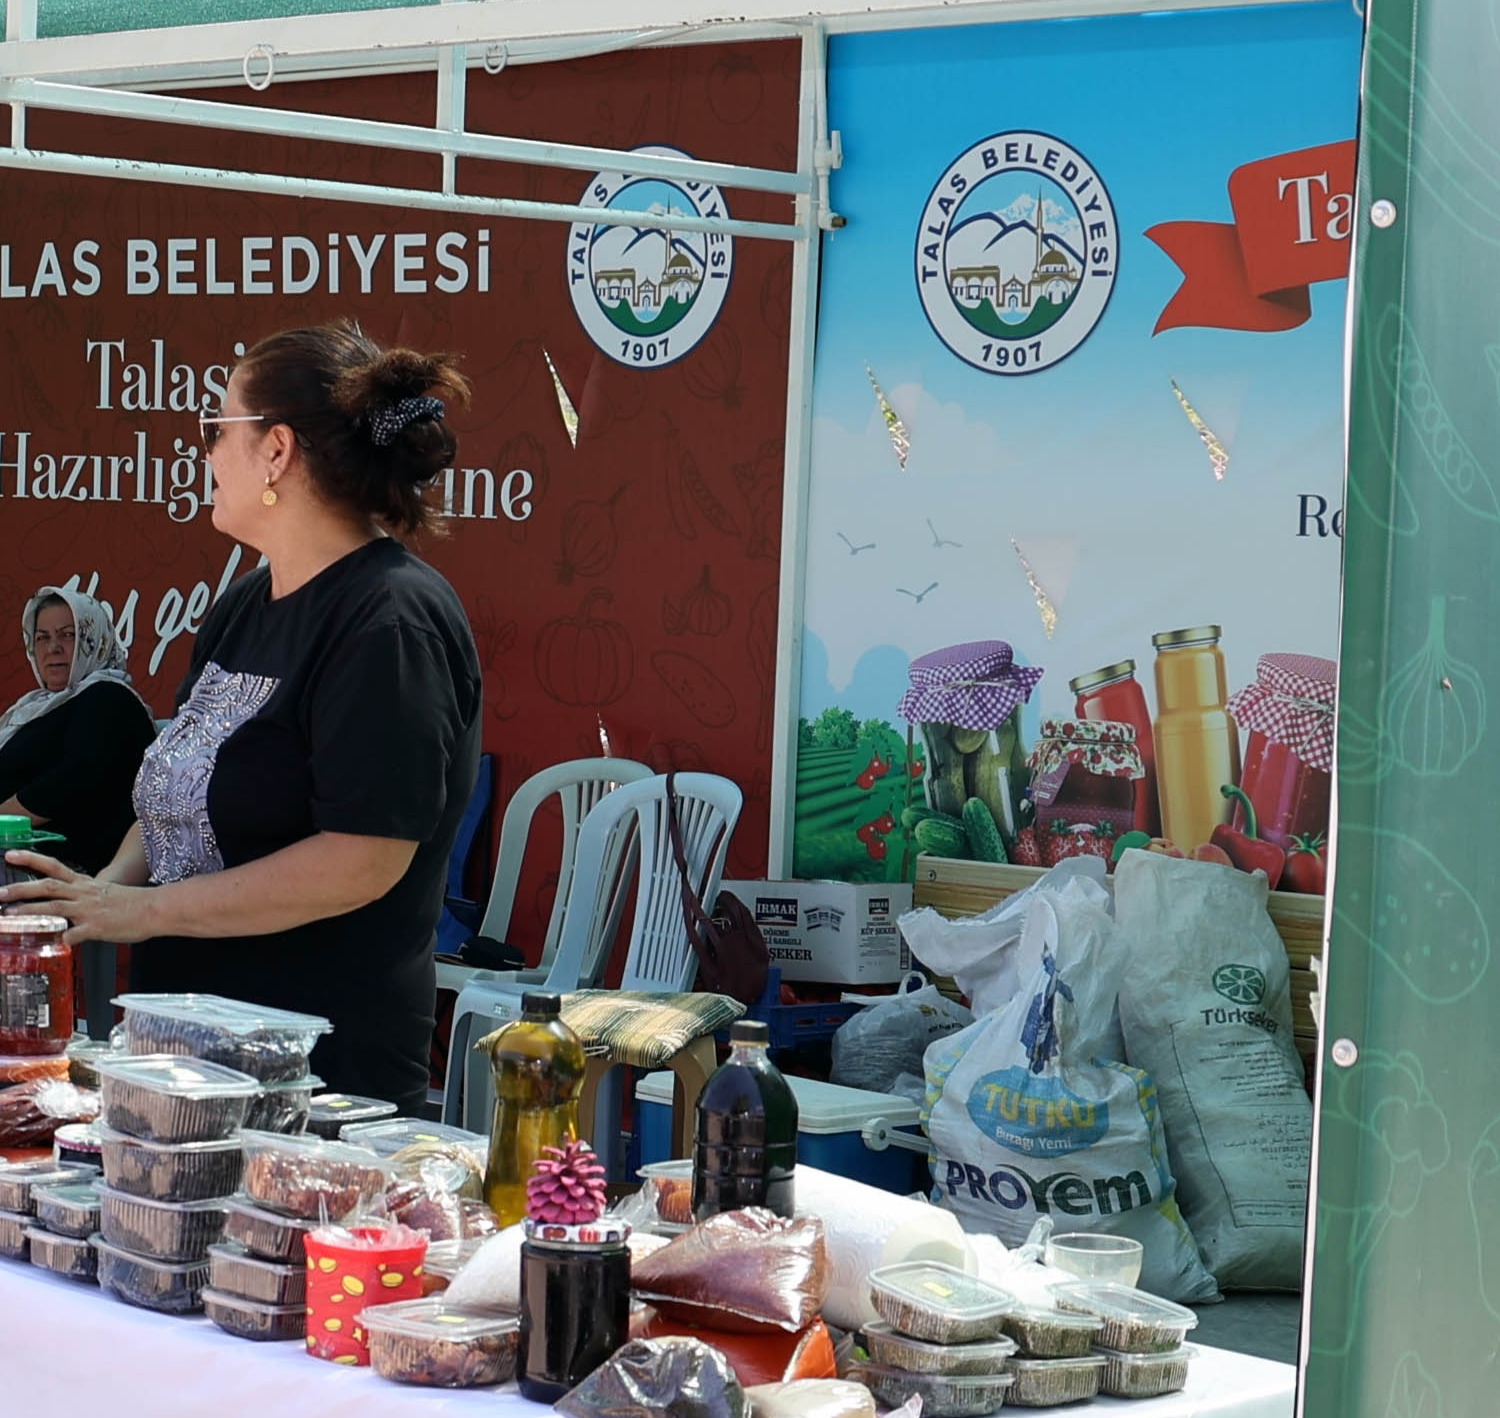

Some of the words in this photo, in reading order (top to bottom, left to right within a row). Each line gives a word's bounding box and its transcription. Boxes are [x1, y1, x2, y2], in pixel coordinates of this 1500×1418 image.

[921, 170, 968, 283] TALAS
[980, 142, 1114, 280] BELEDİYESİ
[571, 183, 608, 286] TALS
[125, 228, 491, 295] BELEDİYESİ
[620, 337, 670, 361] 1907
[981, 340, 1044, 367] 1907
[756, 902, 798, 916] IRMAK
[984, 1083, 1097, 1130] TUTKU
[1038, 1135, 1072, 1150] Yemi
